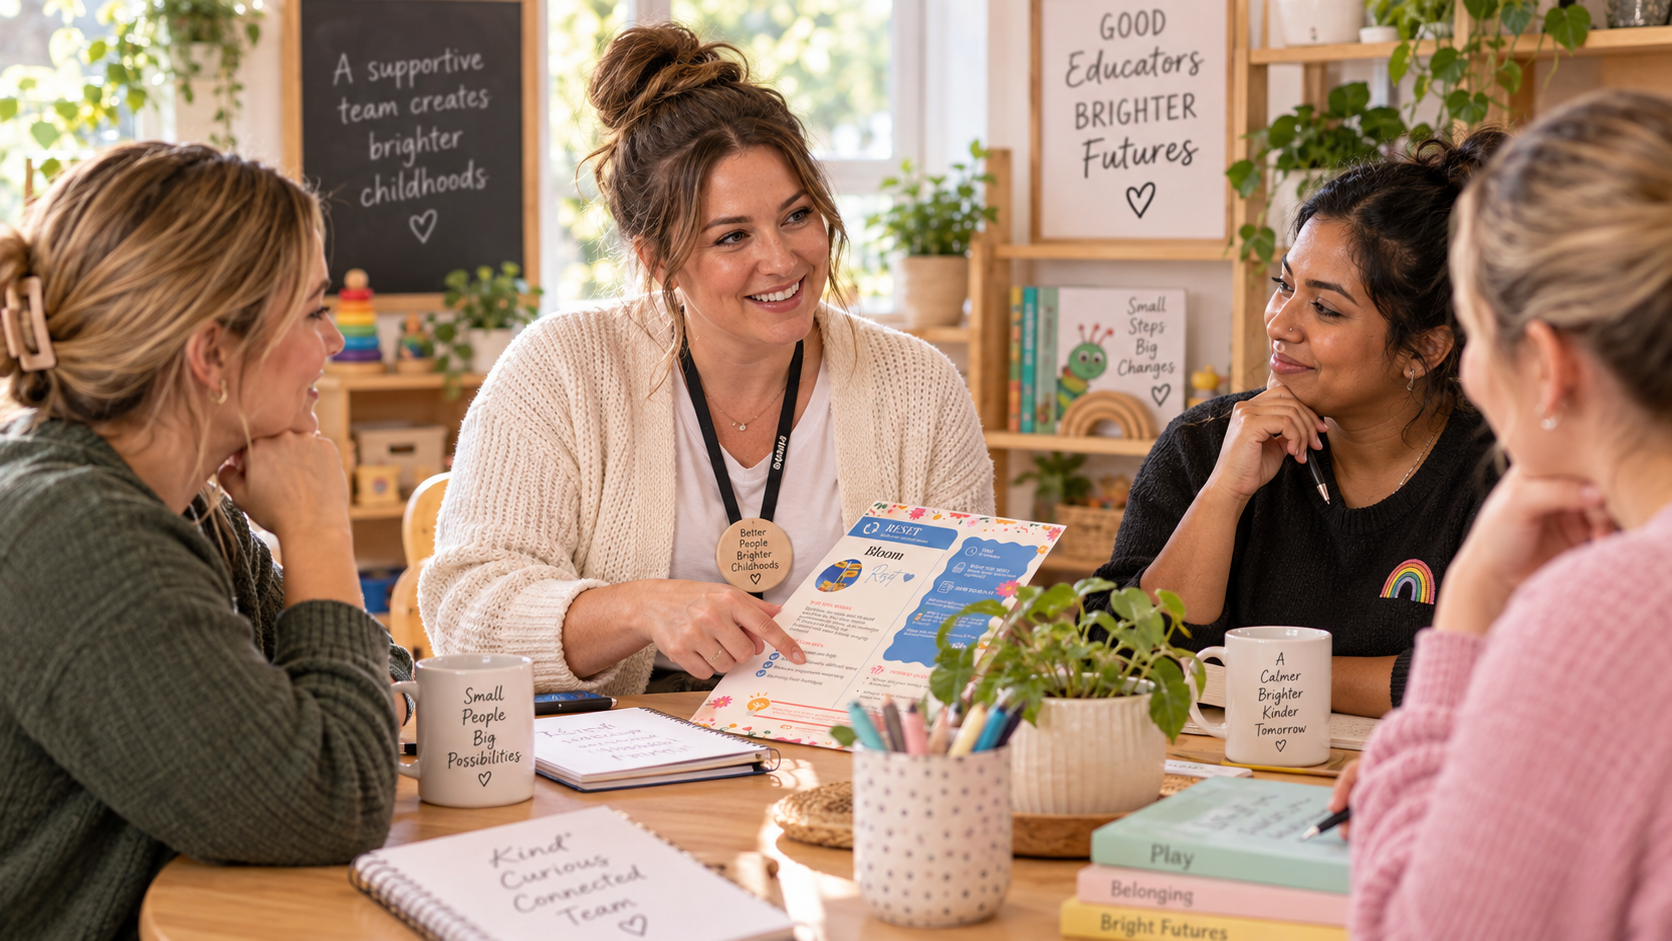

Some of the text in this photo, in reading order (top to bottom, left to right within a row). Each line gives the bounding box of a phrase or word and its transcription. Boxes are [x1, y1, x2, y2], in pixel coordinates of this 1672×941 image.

[1099, 8, 1166, 40] GOOD
[333, 48, 485, 89] A supportive
[1065, 46, 1205, 88] Educators
[337, 84, 490, 124] team creates
[1075, 93, 1197, 130] BRIGHTER
[369, 125, 463, 168] brighter
[1082, 137, 1199, 179] Futures
[360, 159, 488, 207] childhoods
[1127, 296, 1166, 315] Small
[1128, 318, 1166, 337] Steps
[1136, 338, 1157, 360] Big
[1117, 359, 1175, 379] Changes
[740, 529, 766, 538] Better
[885, 523, 922, 536] RESET
[739, 538, 768, 549] People
[864, 546, 904, 560] Bloom
[737, 550, 772, 561] Brighter
[731, 561, 779, 572] Childhoods
[1276, 652, 1285, 666] A
[1260, 669, 1301, 684] Calmer
[463, 685, 505, 705] Small
[1258, 687, 1303, 706] Brighter
[462, 706, 506, 728] People
[1263, 705, 1299, 720] Kinder
[473, 730, 496, 749] Big
[1255, 723, 1307, 737] Tomorrow
[447, 749, 522, 769] Possibilities
[1150, 843, 1195, 871] Play
[500, 855, 610, 891] Curious
[513, 864, 647, 914] Connected
[1111, 880, 1194, 907] Belonging
[555, 898, 639, 927] Team
[1100, 913, 1228, 941] Bright Futures
